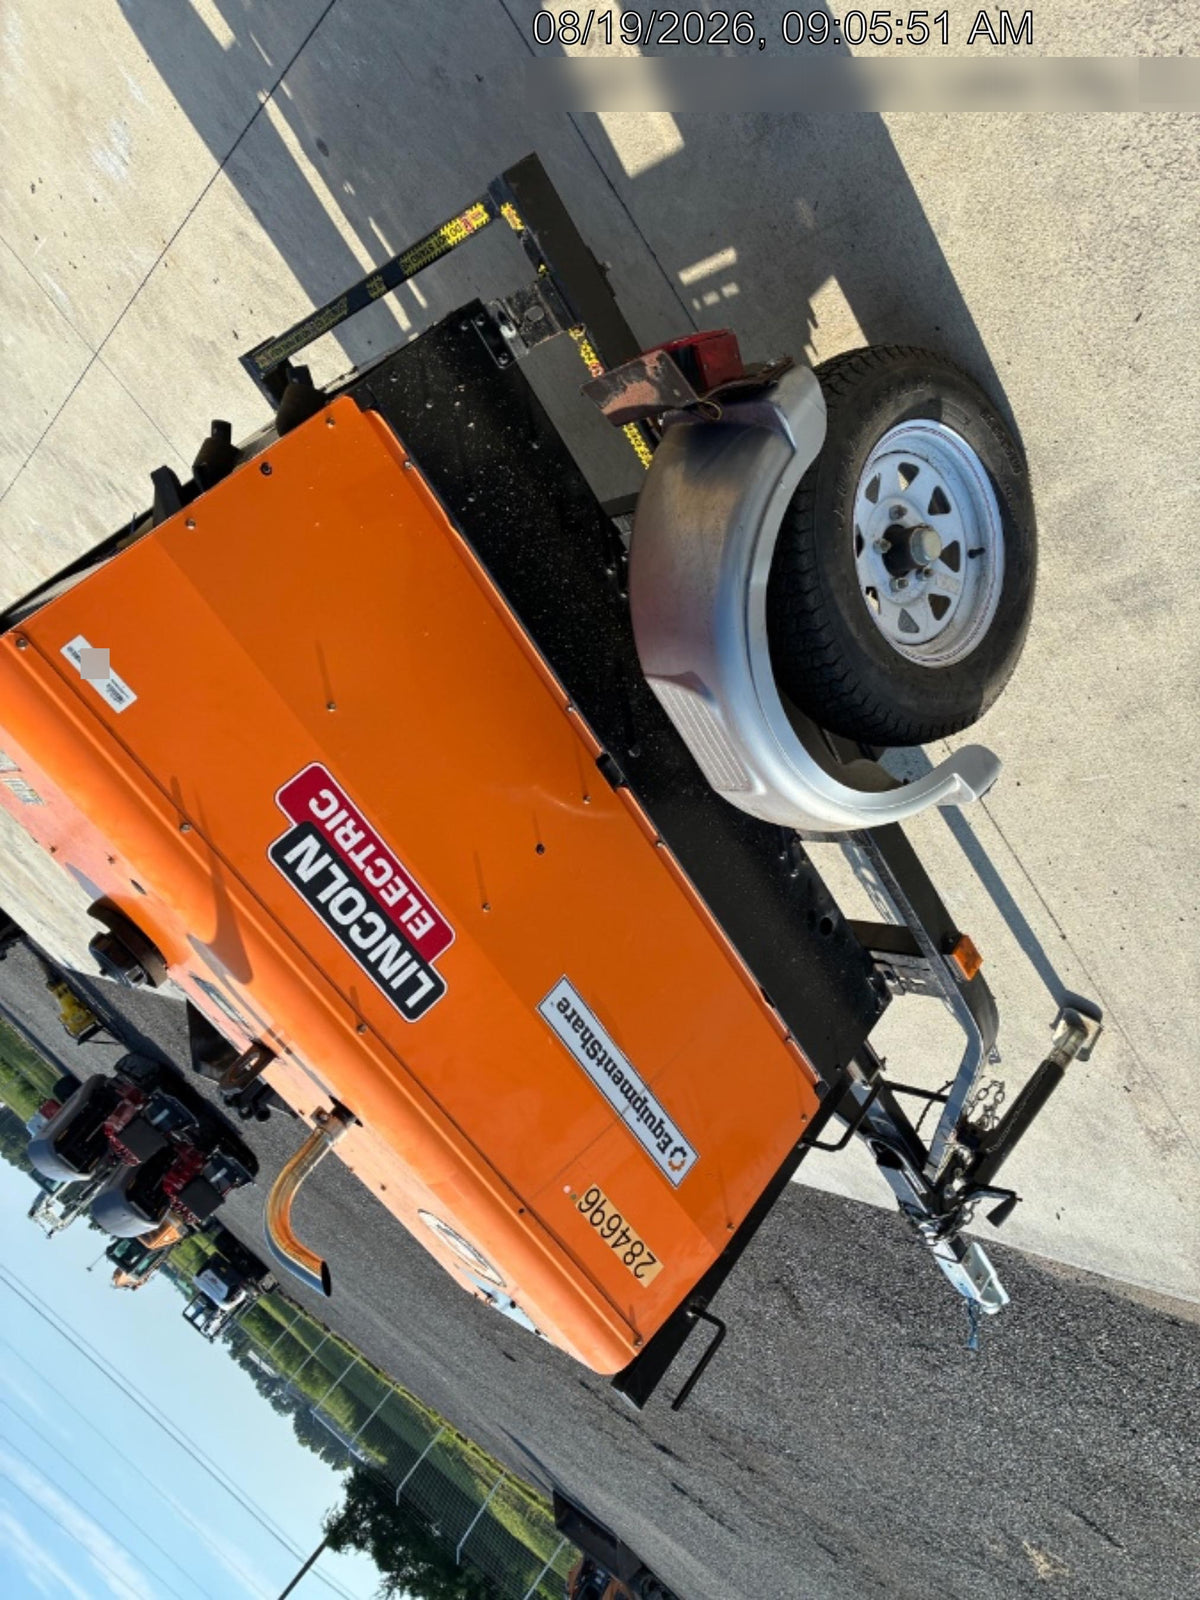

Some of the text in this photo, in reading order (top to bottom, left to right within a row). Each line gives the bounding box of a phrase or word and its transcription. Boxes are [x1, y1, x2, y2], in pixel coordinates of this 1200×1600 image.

[283, 833, 436, 1010] LINCOLN
[308, 787, 437, 941] ELECTRIC
[555, 996, 674, 1155] EquipmentShare
[577, 1187, 657, 1279] 284696
